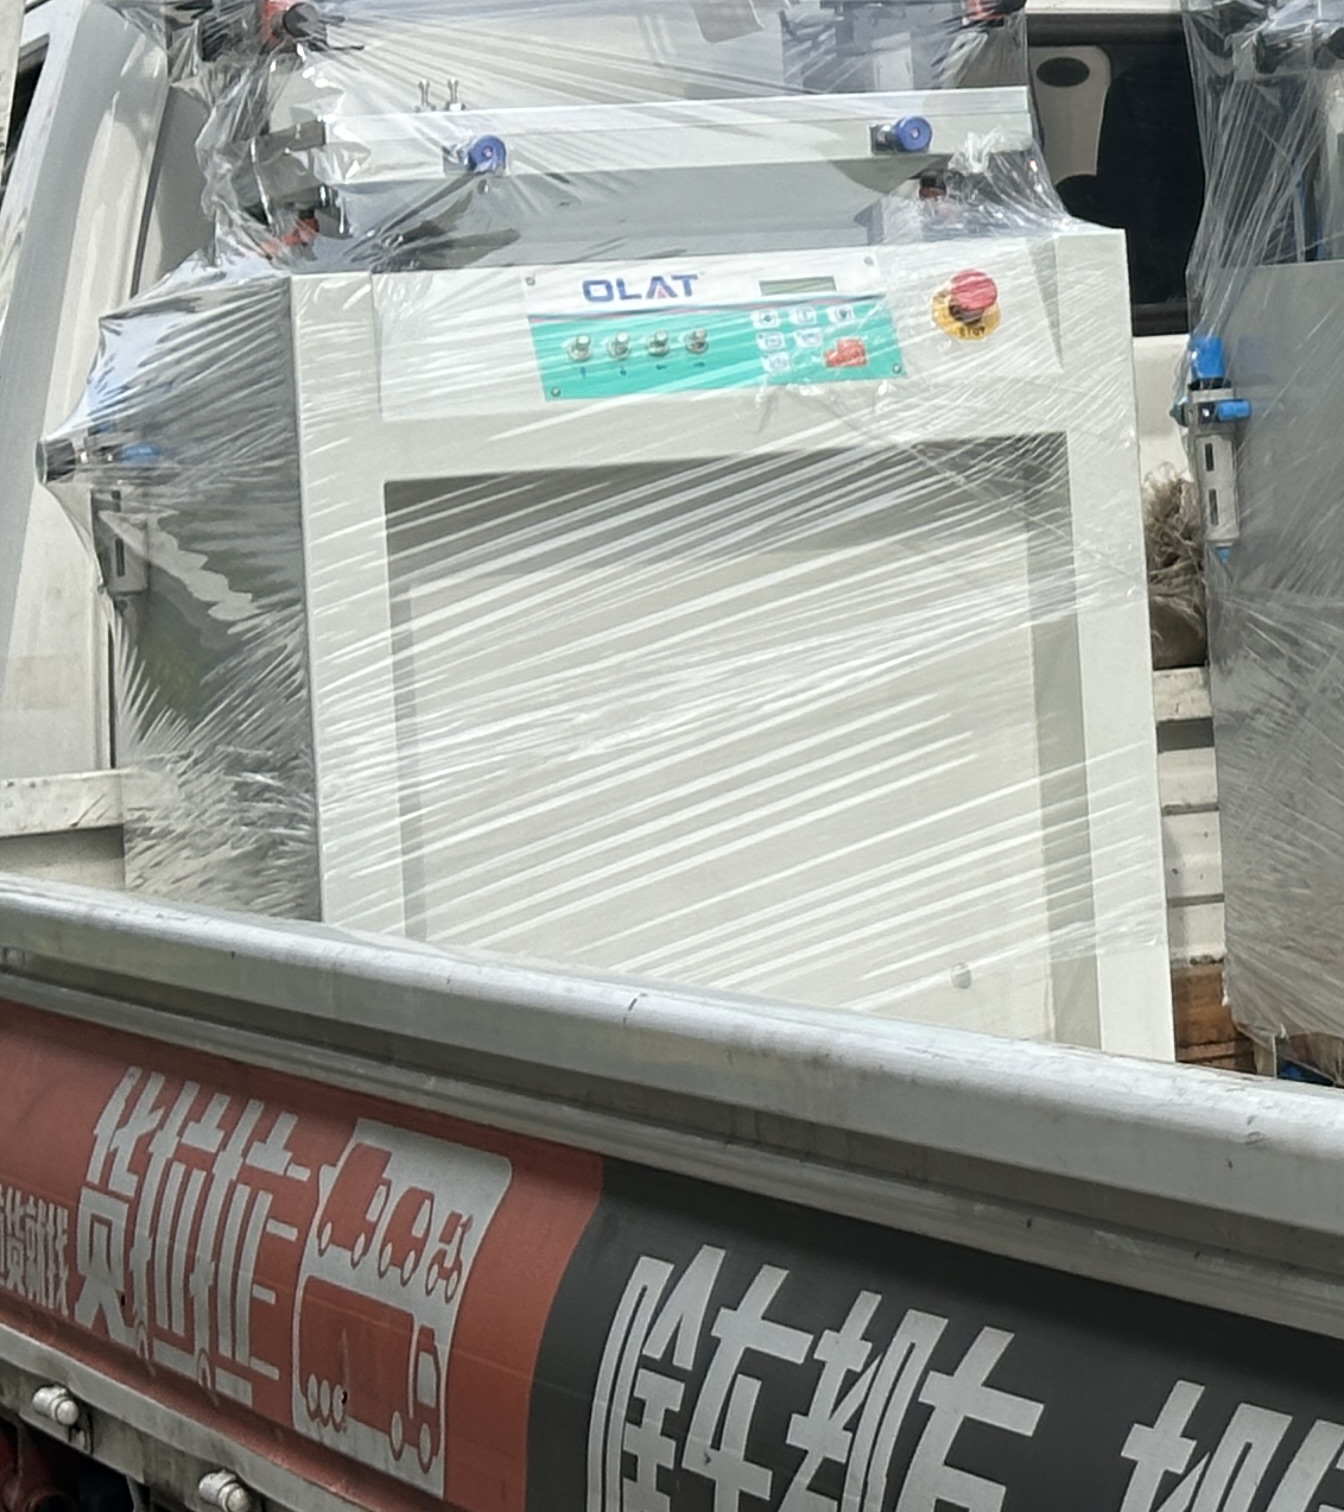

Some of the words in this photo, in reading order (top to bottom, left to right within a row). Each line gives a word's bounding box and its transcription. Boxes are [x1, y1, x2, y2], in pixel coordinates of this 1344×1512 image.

[583, 273, 699, 304] OLAT
[0, 1183, 69, 1318] 货就找
[75, 1065, 311, 1407] 货拉拉
